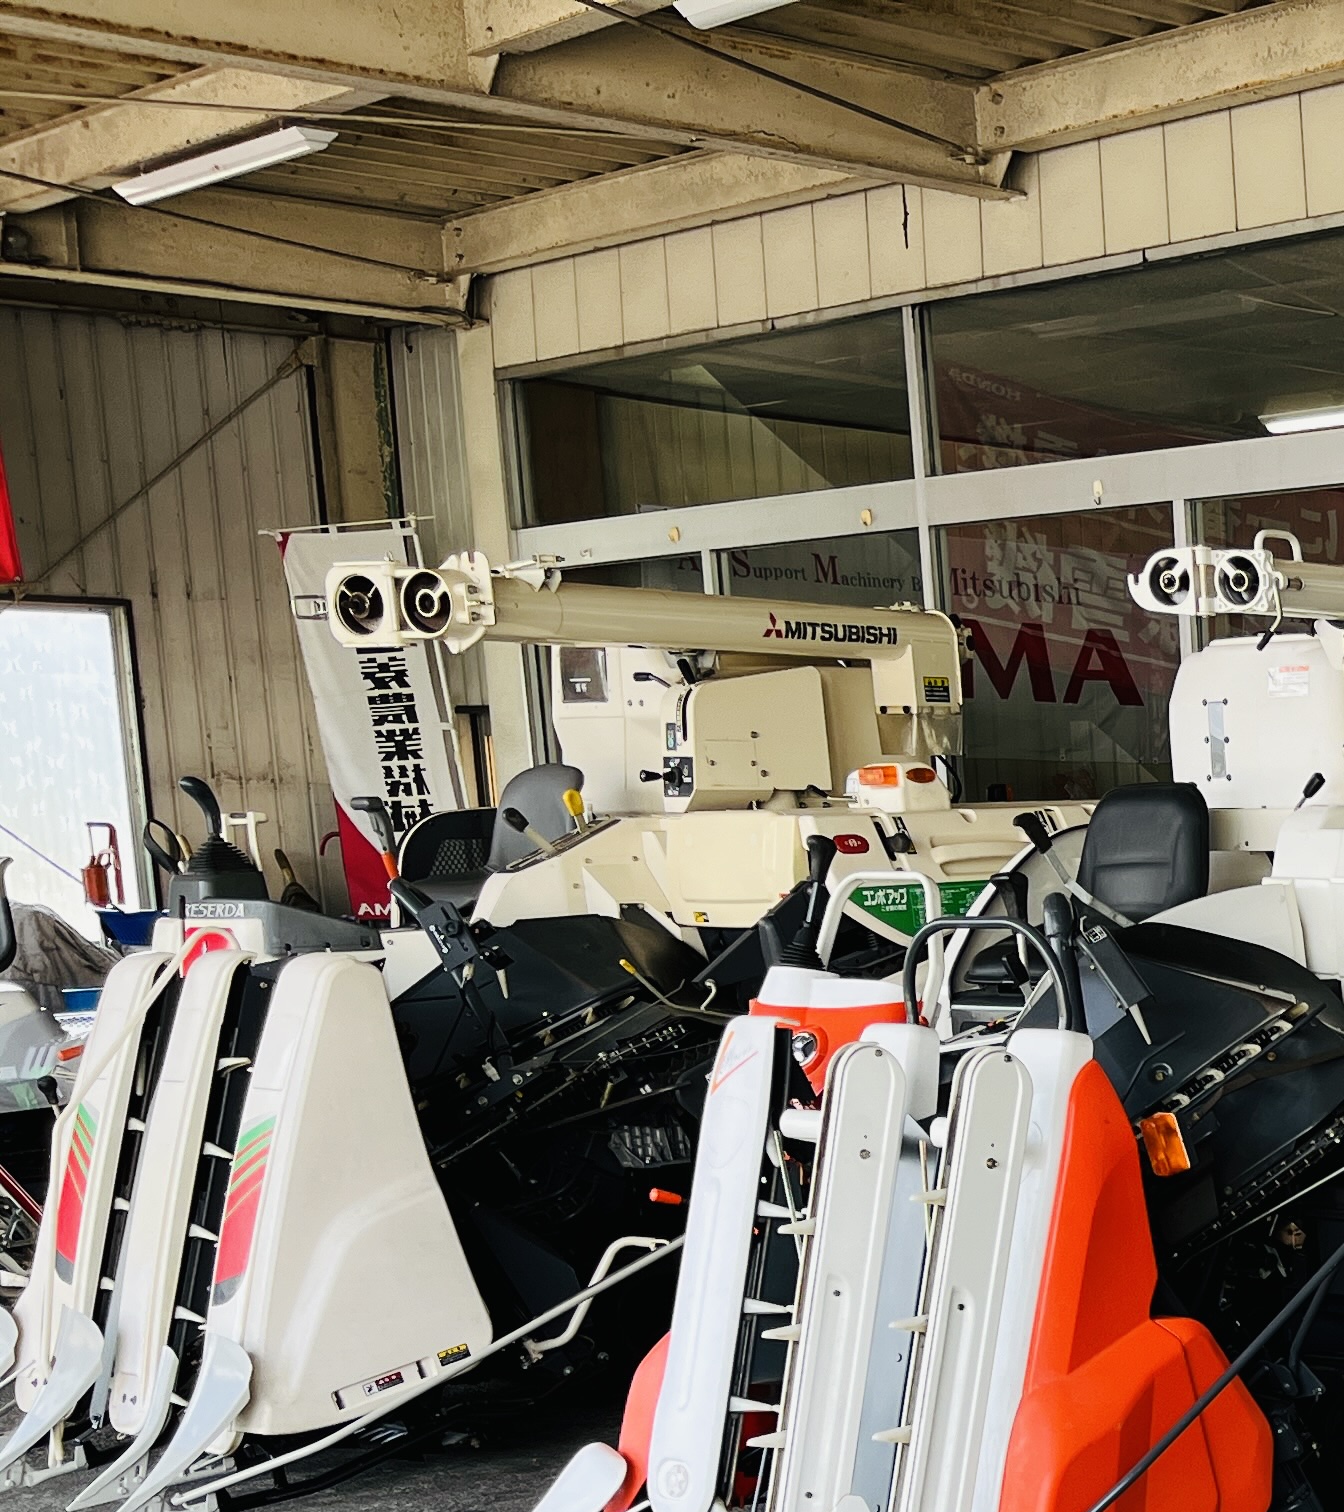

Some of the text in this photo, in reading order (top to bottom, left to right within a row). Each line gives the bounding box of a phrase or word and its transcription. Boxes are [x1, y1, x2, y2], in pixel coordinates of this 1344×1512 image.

[731, 549, 808, 582] Support
[811, 552, 906, 592] Machinery
[783, 620, 898, 645] MITSUBISHI
